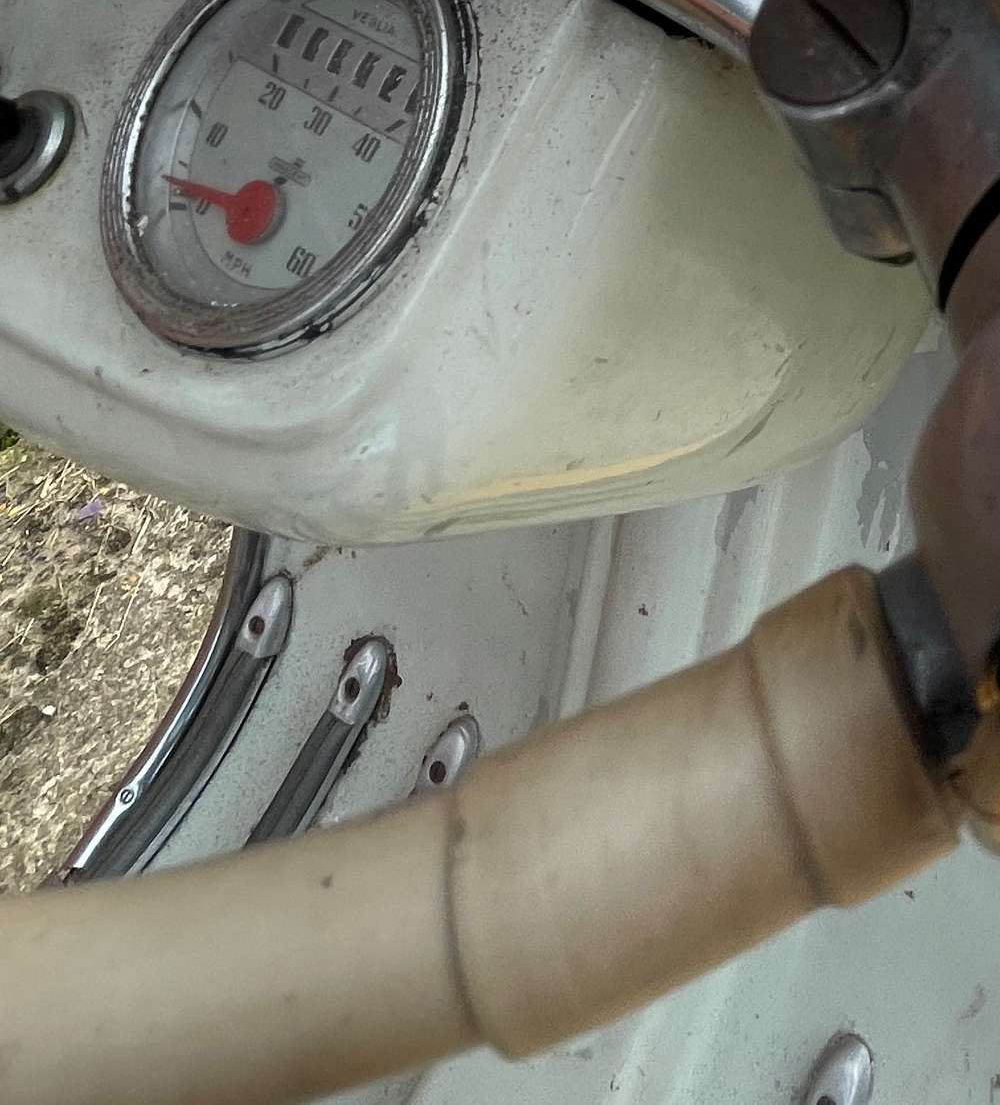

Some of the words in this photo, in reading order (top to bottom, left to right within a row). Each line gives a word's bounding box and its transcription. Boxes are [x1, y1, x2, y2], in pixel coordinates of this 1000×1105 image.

[258, 81, 287, 111] 20
[206, 122, 229, 147] 10
[304, 106, 333, 137] 30
[352, 133, 382, 163] 40
[220, 250, 252, 278] MPH
[286, 246, 317, 277] 60
